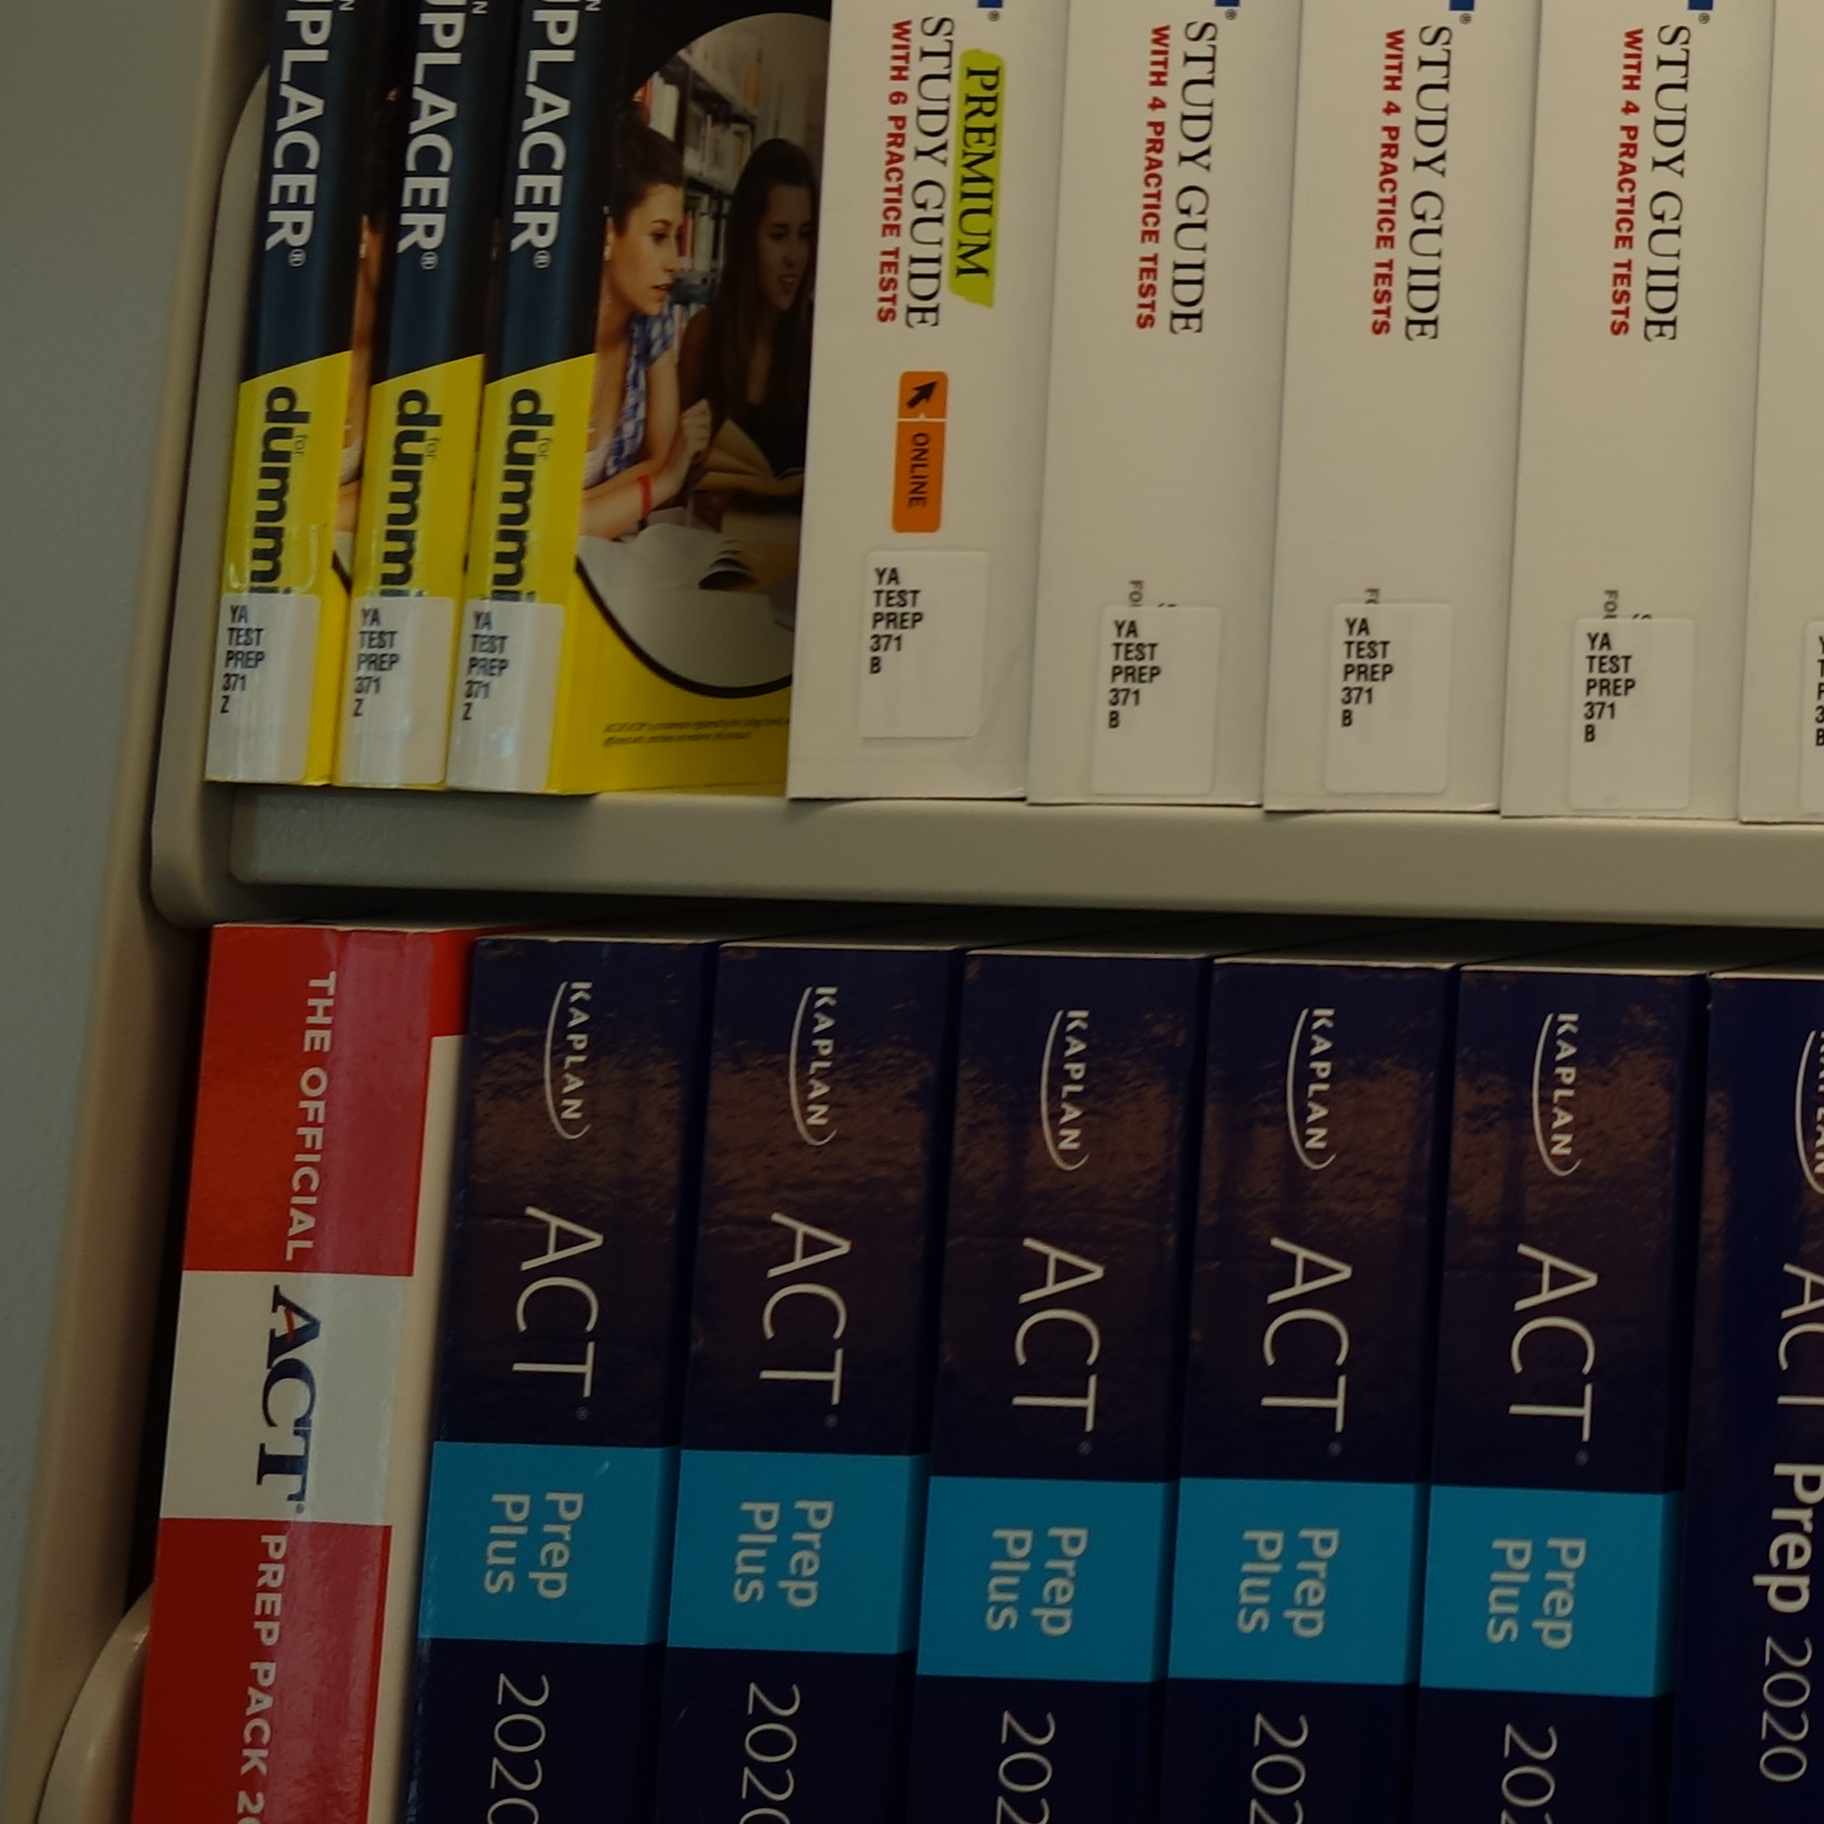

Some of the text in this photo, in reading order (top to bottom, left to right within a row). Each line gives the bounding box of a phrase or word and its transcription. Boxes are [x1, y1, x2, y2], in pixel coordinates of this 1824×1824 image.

[876, 19, 912, 323] WITH 6 PRACTICE TESTS
[905, 16, 955, 329] STUDY GUIDE
[955, 67, 1001, 277] PREMIUM
[1135, 25, 1171, 330] WITH 4 PRACTICE TESTS
[1169, 21, 1218, 335] STUDY GUIDE
[908, 432, 930, 507] ONLINE
[873, 588, 921, 609] TEST
[874, 567, 901, 586] YA
[469, 632, 509, 655] TEST
[472, 610, 492, 631] YA
[869, 633, 903, 653] 371
[871, 611, 924, 630] PREP
[461, 678, 490, 700] 371
[466, 655, 509, 677] PREP
[869, 655, 882, 675] B
[461, 701, 473, 722] Z
[560, 981, 592, 1120] KAPLAN
[286, 970, 337, 1261] THE OFFICIAL
[483, 1493, 531, 1594] Plus
[527, 1491, 584, 1599] Prep
[240, 1534, 289, 1776] PREP PACK
